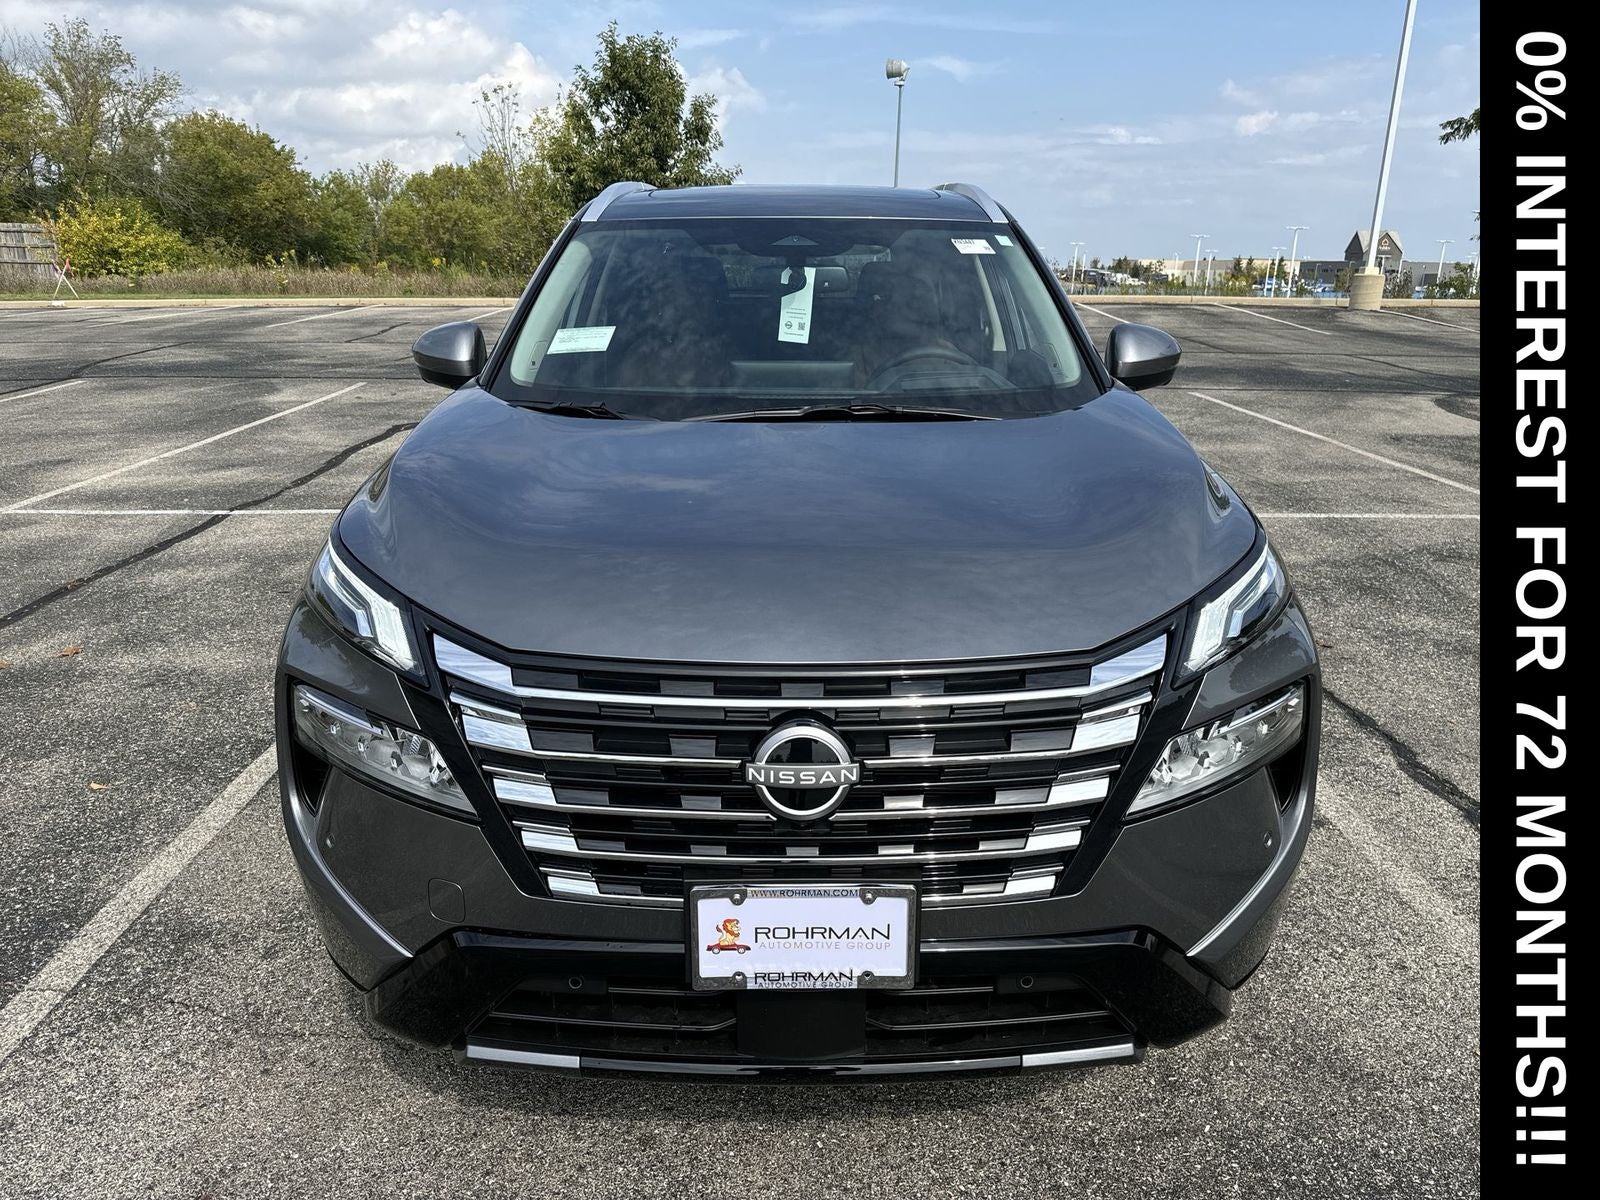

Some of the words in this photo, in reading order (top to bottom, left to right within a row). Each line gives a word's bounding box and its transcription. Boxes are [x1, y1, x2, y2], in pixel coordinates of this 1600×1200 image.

[748, 767, 857, 785] NISSAN
[750, 888, 859, 898] WWW.ROHRMAN.COM
[754, 923, 891, 943] ROHRMAN
[759, 941, 841, 950] AUTOMOTIVE
[846, 941, 891, 951] GROUP
[754, 968, 853, 985] ROHRMAN
[758, 981, 817, 989] AUTOMOTIVE
[821, 981, 853, 989] GROUP
